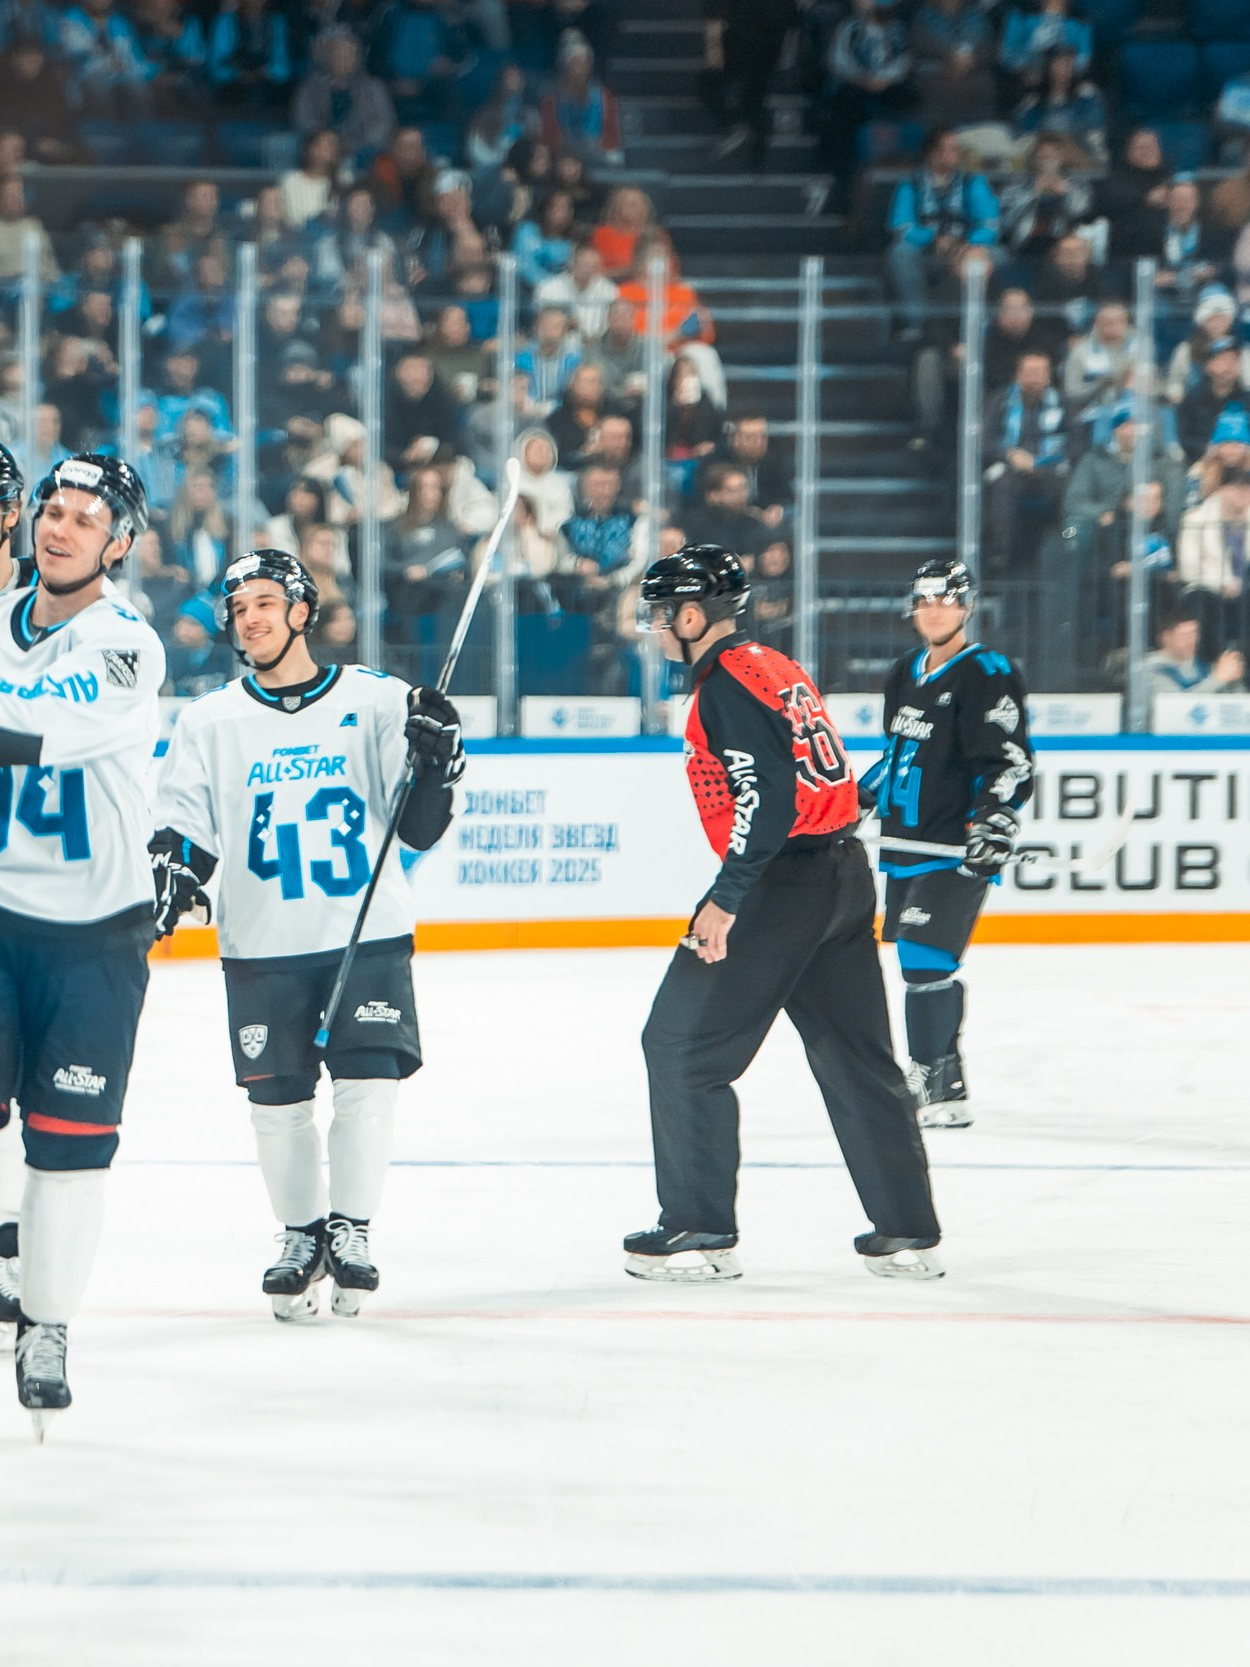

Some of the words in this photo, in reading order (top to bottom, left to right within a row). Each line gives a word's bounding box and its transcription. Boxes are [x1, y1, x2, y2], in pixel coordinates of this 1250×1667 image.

[876, 735, 923, 828] 14
[247, 785, 372, 901] 43
[459, 823, 544, 853] НЕДЕЛЯ
[551, 823, 620, 851] ЗВЕЗД
[458, 859, 543, 884] ХОККЕЯ
[550, 859, 602, 882] 2025
[1014, 843, 1221, 892] CLUB
